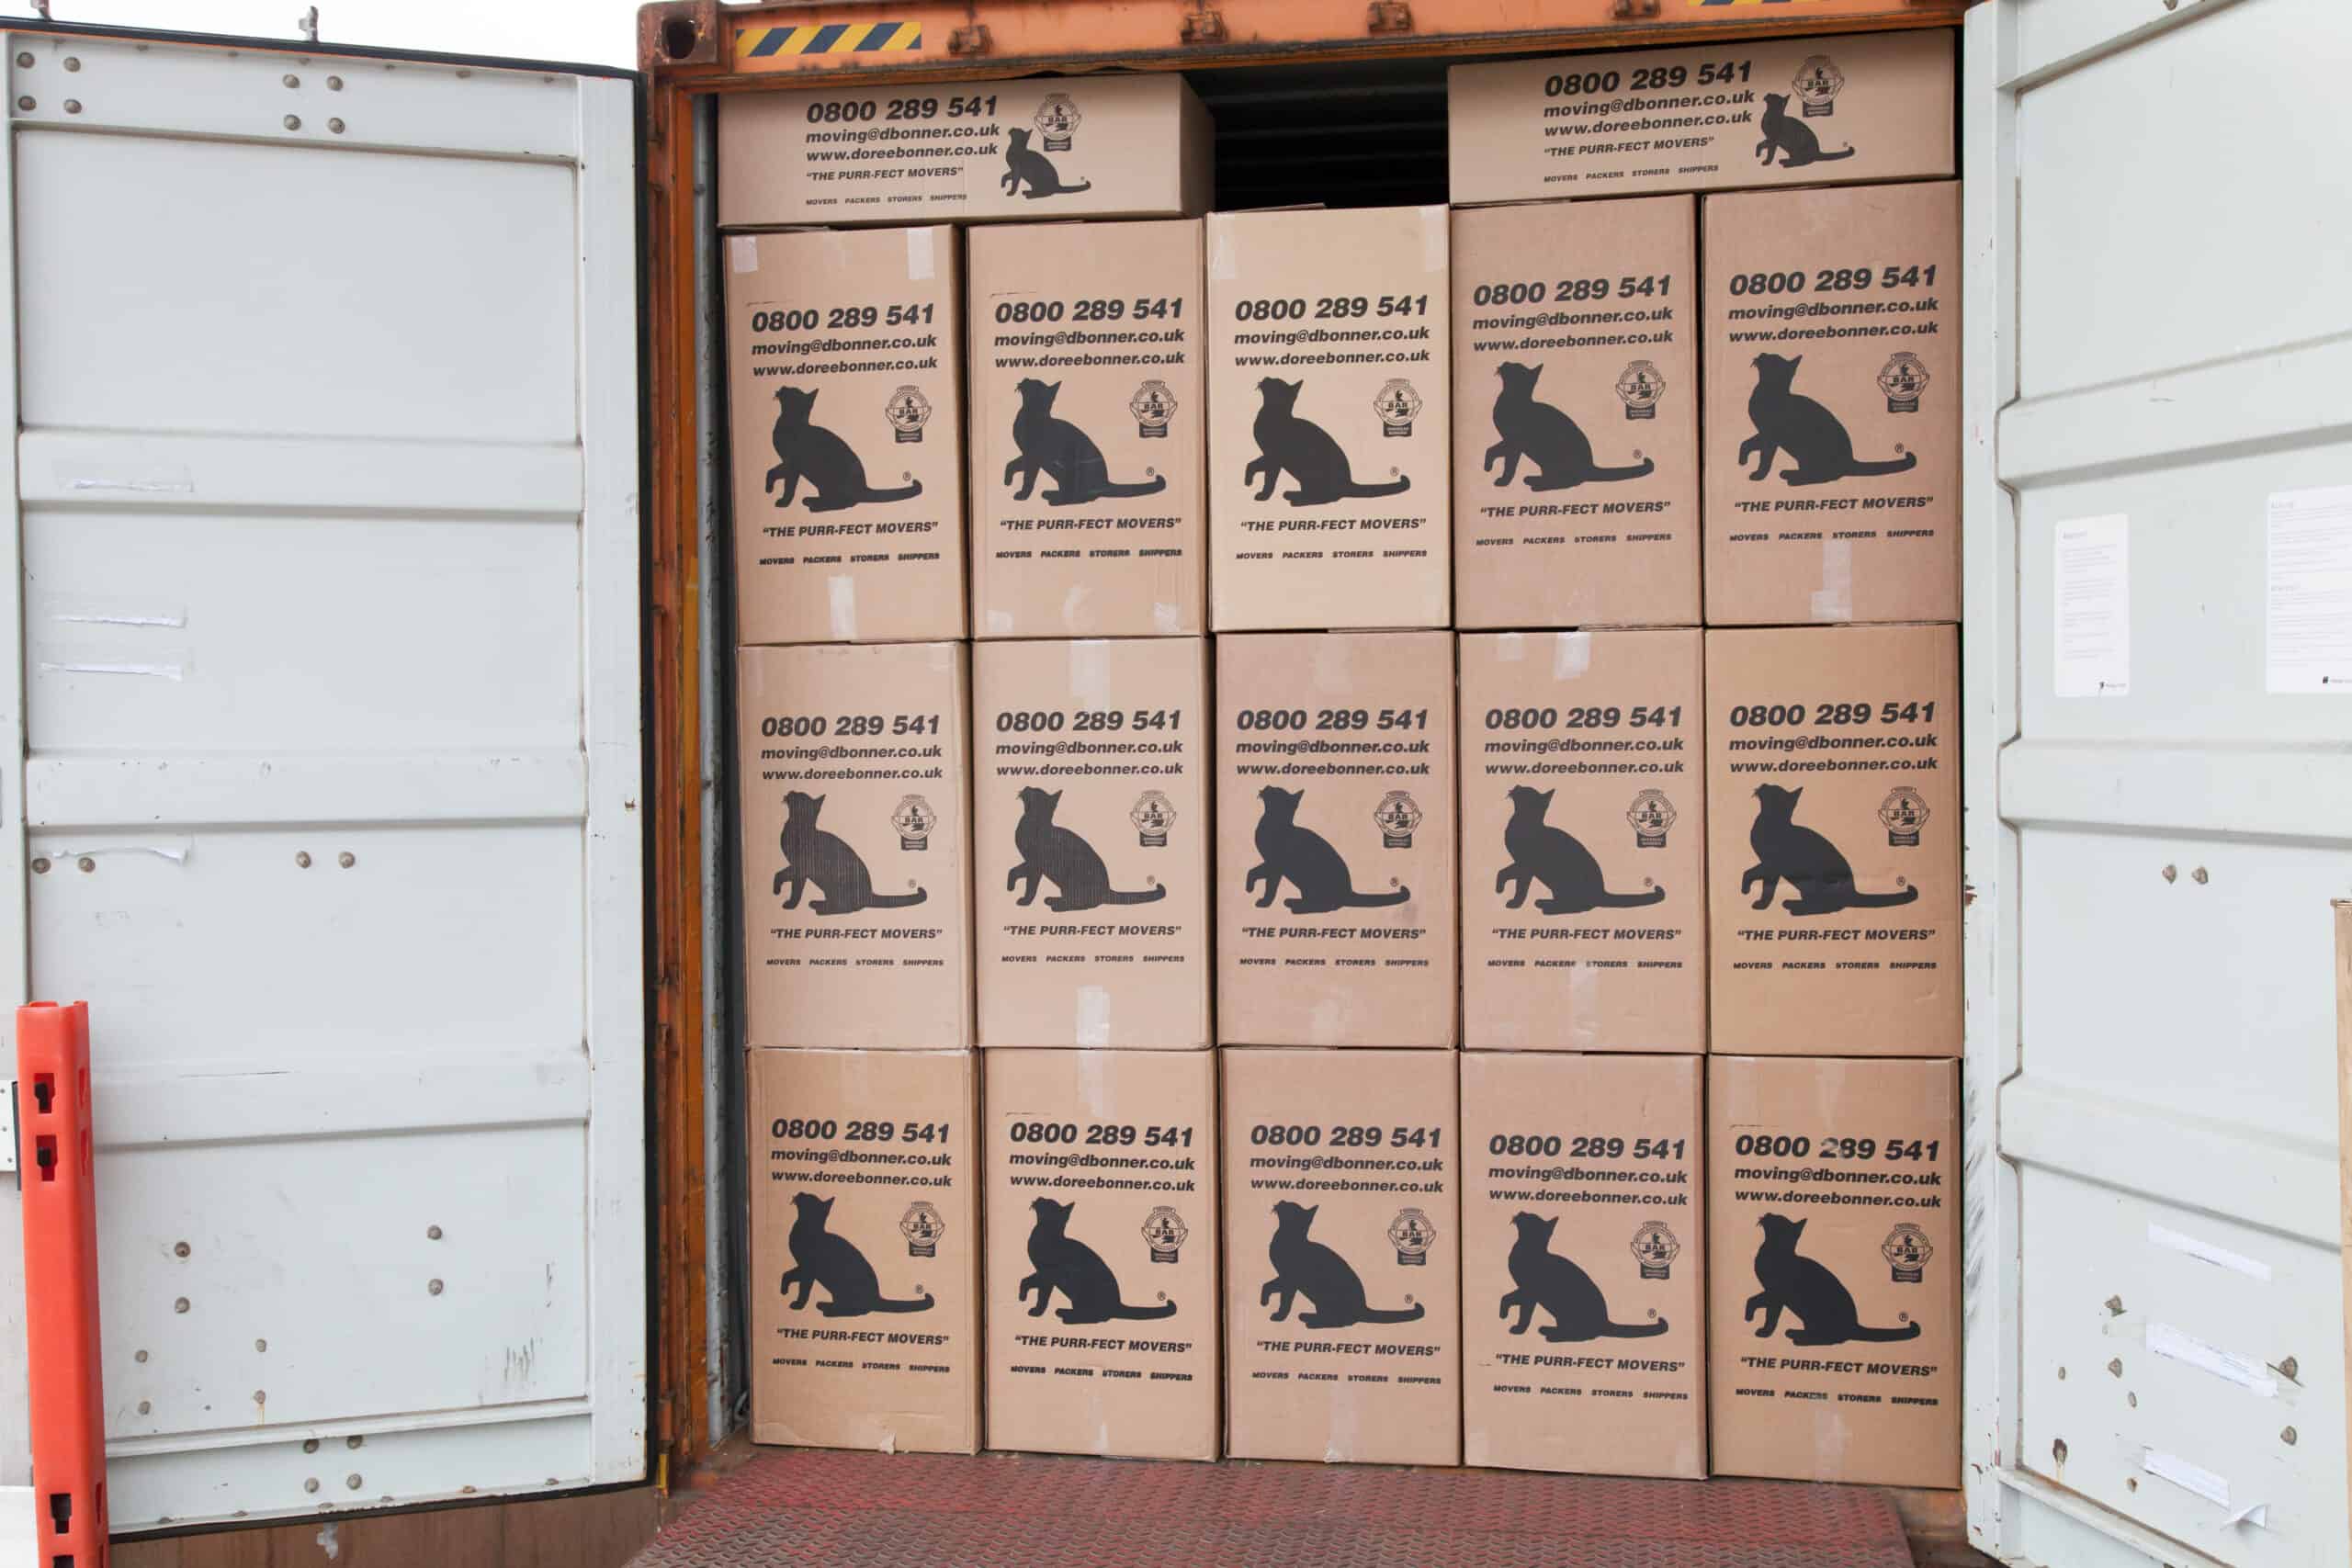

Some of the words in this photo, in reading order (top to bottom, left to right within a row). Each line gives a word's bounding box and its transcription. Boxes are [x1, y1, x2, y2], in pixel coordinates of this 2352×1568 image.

[1545, 72, 1620, 96] 0800
[1631, 66, 1687, 90] 289
[1698, 61, 1750, 85] 541
[808, 101, 876, 123] 0800
[887, 99, 937, 119] 289
[948, 96, 996, 118] 541
[1544, 90, 1754, 118] moving@dbonner.co.uk
[1545, 110, 1751, 136] www.doreebonner.co.uk
[806, 124, 1000, 143] moving@dbonner.co.uk
[807, 143, 998, 162] www.doreebonner.co.uk
[1578, 141, 1650, 154] PURR-FECT
[838, 169, 904, 180] PURR-FECT
[1632, 168, 1669, 176] STORERS
[1679, 164, 1718, 174] SHIPPERS
[1730, 272, 1805, 296] 0800
[1815, 268, 1871, 292] 289
[1882, 265, 1936, 288] 541
[1474, 282, 1546, 306] 0800
[1555, 278, 1610, 301] 289
[1617, 275, 1670, 299] 541
[995, 301, 1064, 323] 0800
[1072, 299, 1125, 321] 289
[1132, 298, 1182, 320] 541
[1235, 299, 1306, 321] 0800
[1315, 297, 1368, 319] 289
[1376, 294, 1428, 317] 541
[1728, 298, 1939, 320] moving@dbonner.co.uk
[752, 310, 819, 333] 0800
[827, 306, 877, 329] 289
[886, 303, 933, 326] 541
[1473, 307, 1672, 330] moving@dbonner.co.uk
[994, 329, 1185, 347] moving@dbonner.co.uk
[1235, 326, 1430, 345] moving@dbonner.co.uk
[1474, 330, 1673, 351] www.doreebonner.co.uk
[1729, 321, 1938, 342] www.doreebonner.co.uk
[752, 333, 937, 355] moving@dbonner.co.uk
[753, 356, 937, 377] www.doreebonner.co.uk
[995, 351, 1185, 367] www.doreebonner.co.uk
[1235, 349, 1430, 367] www.doreebonner.co.uk
[1519, 503, 1600, 516] PURR-FECT
[1774, 499, 1859, 511] PURR-FECT
[1278, 519, 1357, 531] PURR-FECT
[997, 711, 1064, 732] 0800
[1073, 711, 1124, 731] 289
[1132, 709, 1181, 730] 541
[1237, 710, 1307, 730] 0800
[1316, 709, 1369, 730] 289
[1376, 709, 1428, 729] 541
[1486, 708, 1557, 729] 0800
[1566, 707, 1621, 728] 289
[1629, 705, 1681, 728] 541
[1730, 705, 1805, 727] 0800
[1814, 703, 1871, 725] 289
[1880, 702, 1935, 724] 541
[762, 716, 827, 737] 0800
[834, 716, 884, 736] 289
[892, 715, 939, 735] 541
[996, 740, 1183, 757] moving@dbonner.co.uk
[1236, 739, 1430, 755] moving@dbonner.co.uk
[1485, 738, 1683, 754] moving@dbonner.co.uk
[1729, 733, 1937, 752] moving@dbonner.co.uk
[761, 744, 941, 761] moving@dbonner.co.uk
[763, 767, 943, 779] www.doreebonner.co.uk
[997, 762, 1183, 775] www.doreebonner.co.uk
[1237, 762, 1430, 774] www.doreebonner.co.uk
[1486, 761, 1683, 773] www.doreebonner.co.uk
[1730, 757, 1938, 773] www.doreebonner.co.uk
[1039, 926, 1115, 935] PURR-FECT
[1279, 928, 1357, 939] PURR-FECT
[1778, 930, 1861, 941] PURR-FECT
[772, 1119, 837, 1139] 0800
[845, 1121, 894, 1142] 289
[901, 1122, 949, 1144] 541
[1011, 1122, 1078, 1144] 0800
[1085, 1124, 1136, 1145] 289
[1144, 1126, 1193, 1147] 541
[1251, 1125, 1321, 1145] 0800
[1329, 1126, 1382, 1146] 289
[1390, 1127, 1441, 1148] 541
[1489, 1134, 1561, 1156] 0800
[1569, 1136, 1624, 1158] 289
[1633, 1139, 1685, 1159] 541
[1736, 1134, 1810, 1157] 0800
[1819, 1137, 1876, 1159] 289
[1884, 1139, 1939, 1161] 541
[771, 1148, 952, 1166] moving@dbonner.co.uk
[1010, 1153, 1195, 1170] moving@dbonner.co.uk
[1250, 1156, 1443, 1171] moving@dbonner.co.uk
[772, 1171, 952, 1187] www.doreebonner.co.uk
[1011, 1176, 1195, 1191] www.doreebonner.co.uk
[1488, 1166, 1687, 1183] moving@dbonner.co.uk
[1735, 1167, 1941, 1185] moving@dbonner.co.uk
[1251, 1178, 1443, 1192] www.doreebonner.co.uk
[1489, 1189, 1687, 1205] www.doreebonner.co.uk
[1736, 1190, 1940, 1207] www.doreebonner.co.uk
[1051, 1337, 1125, 1350] PURR-FECT
[1533, 1355, 1614, 1369] PURR-FECT
[1780, 1359, 1864, 1373] PURR-FECT
[1493, 1384, 1531, 1393] MOVERS
[1540, 1387, 1582, 1395] PACKERS
[1591, 1389, 1633, 1398] STORERS
[1643, 1392, 1688, 1400] SHIPPERS
